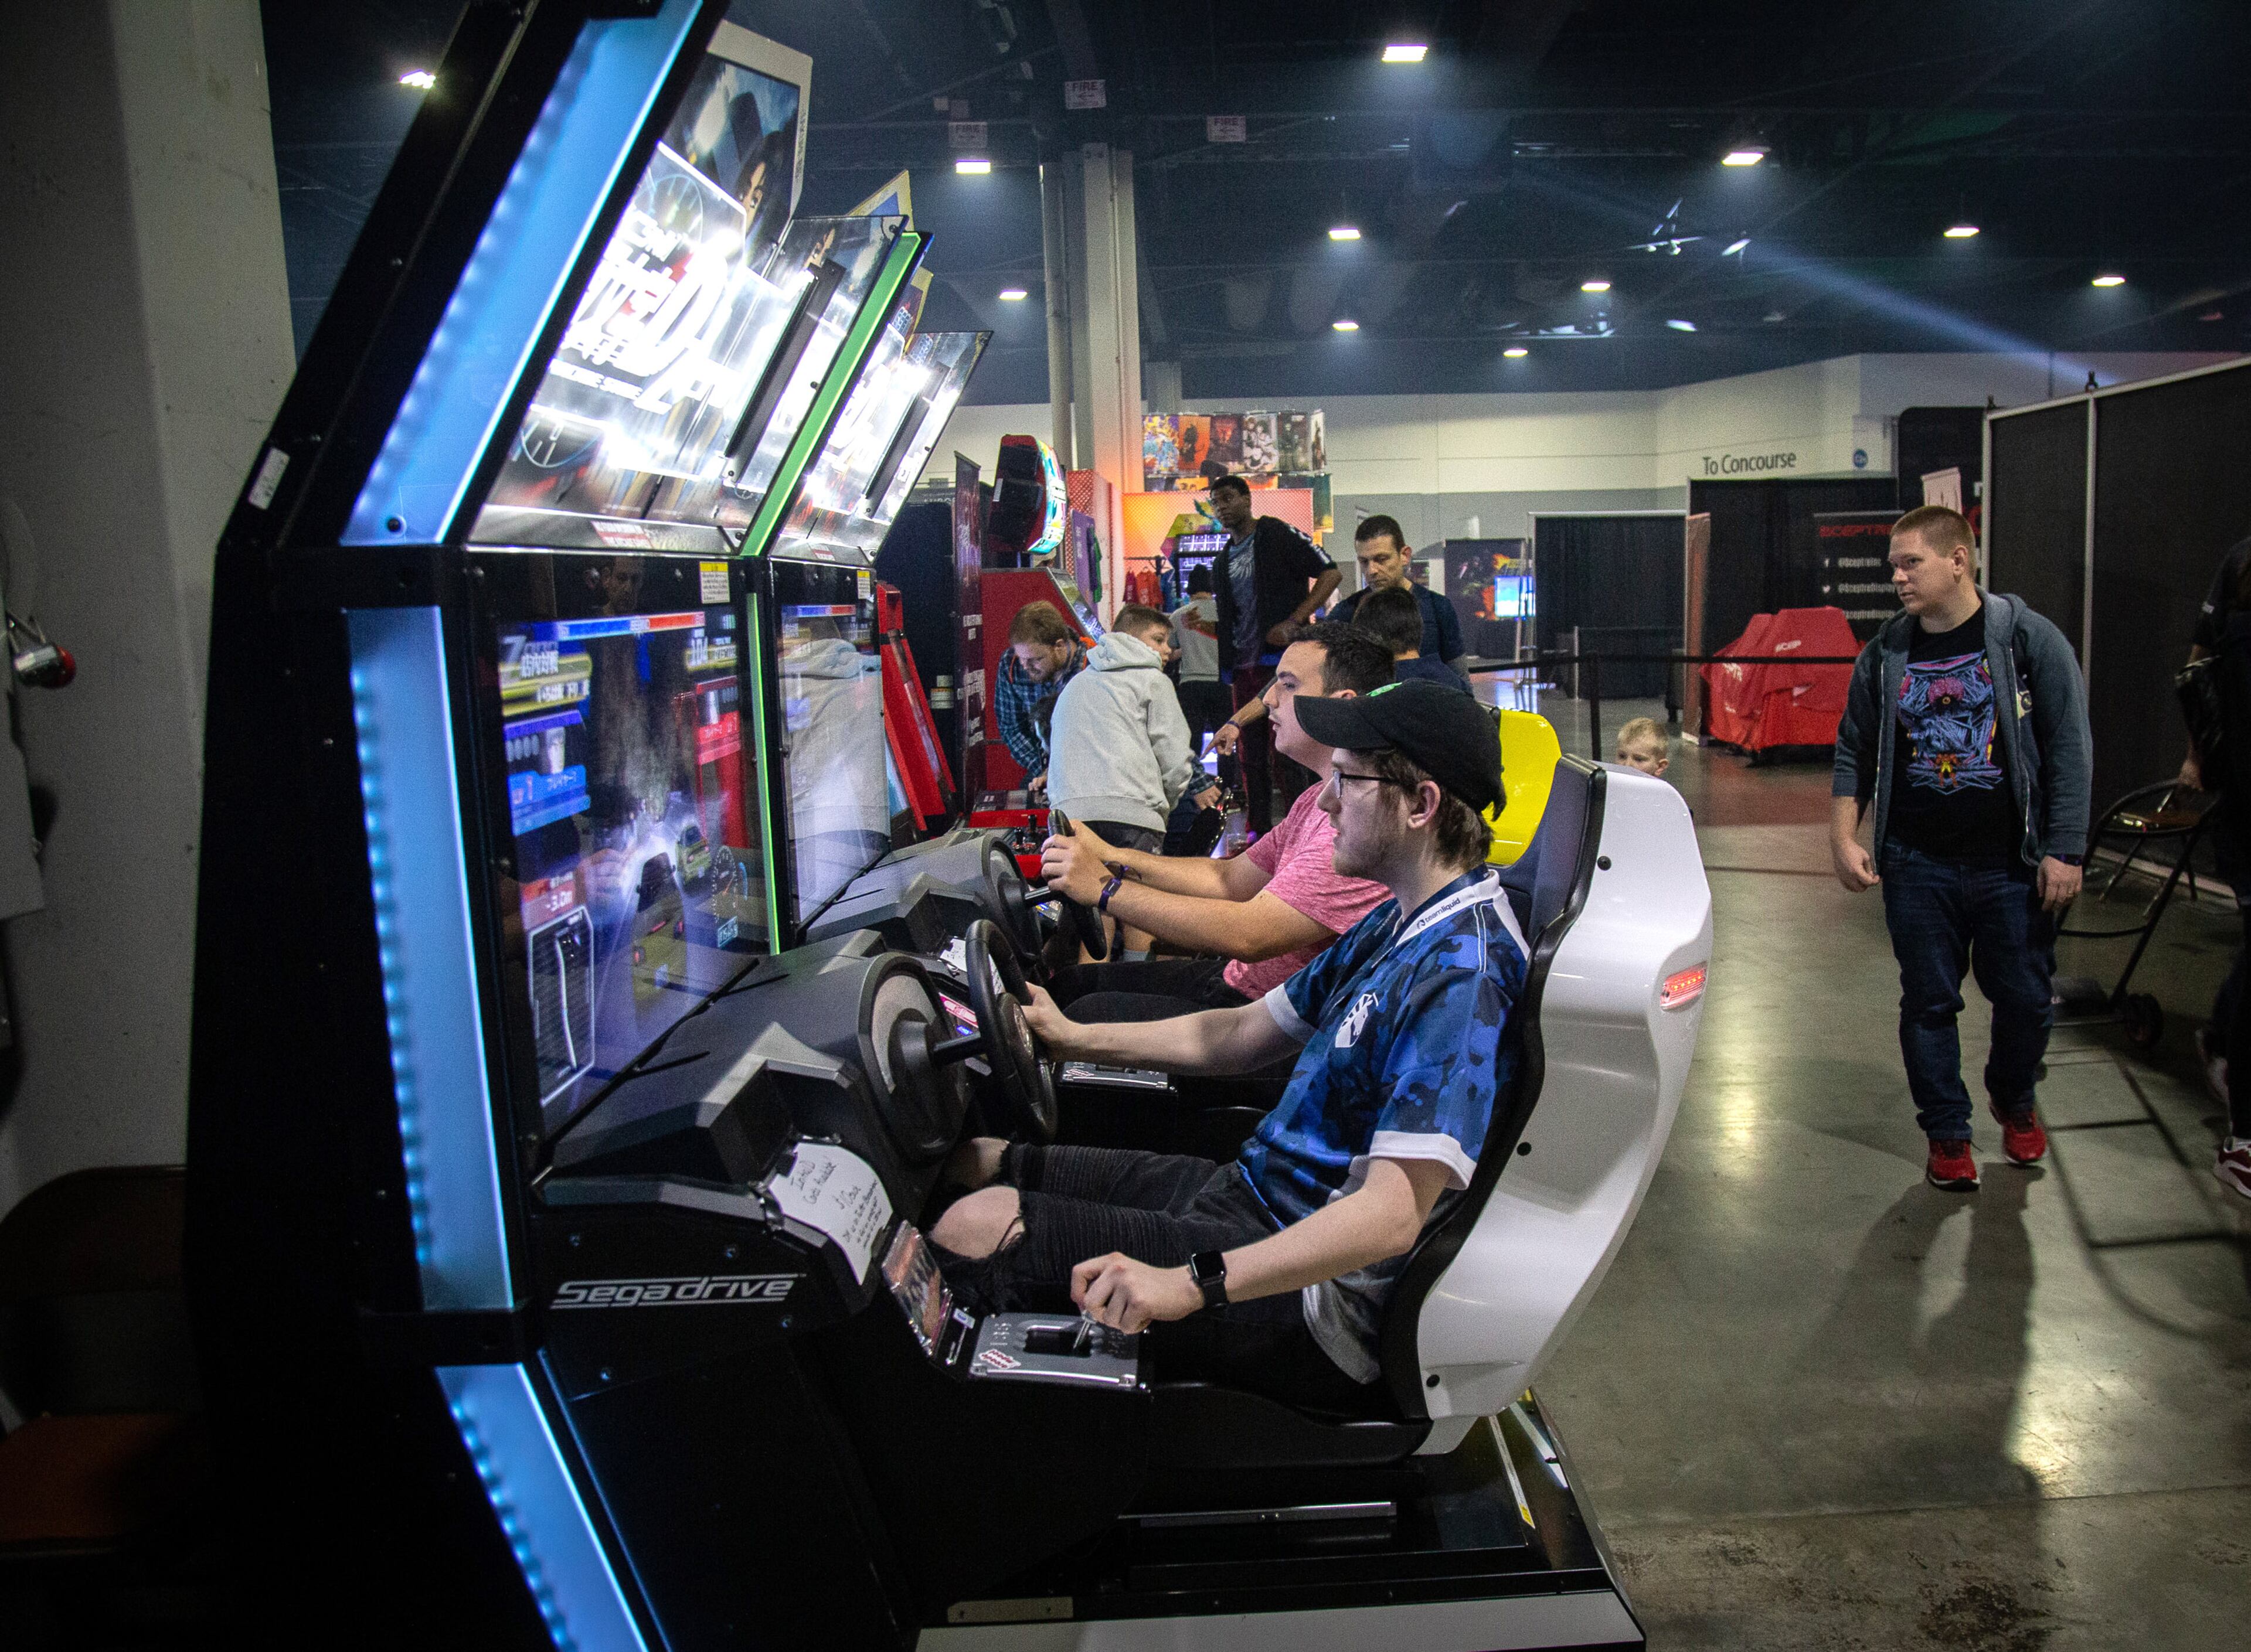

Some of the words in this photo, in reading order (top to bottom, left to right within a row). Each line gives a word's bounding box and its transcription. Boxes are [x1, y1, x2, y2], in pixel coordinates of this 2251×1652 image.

[1072, 82, 1098, 91] FIRE
[1214, 117, 1239, 126] FIRE
[1702, 456, 1718, 475] To
[1722, 451, 1797, 474] Concourse
